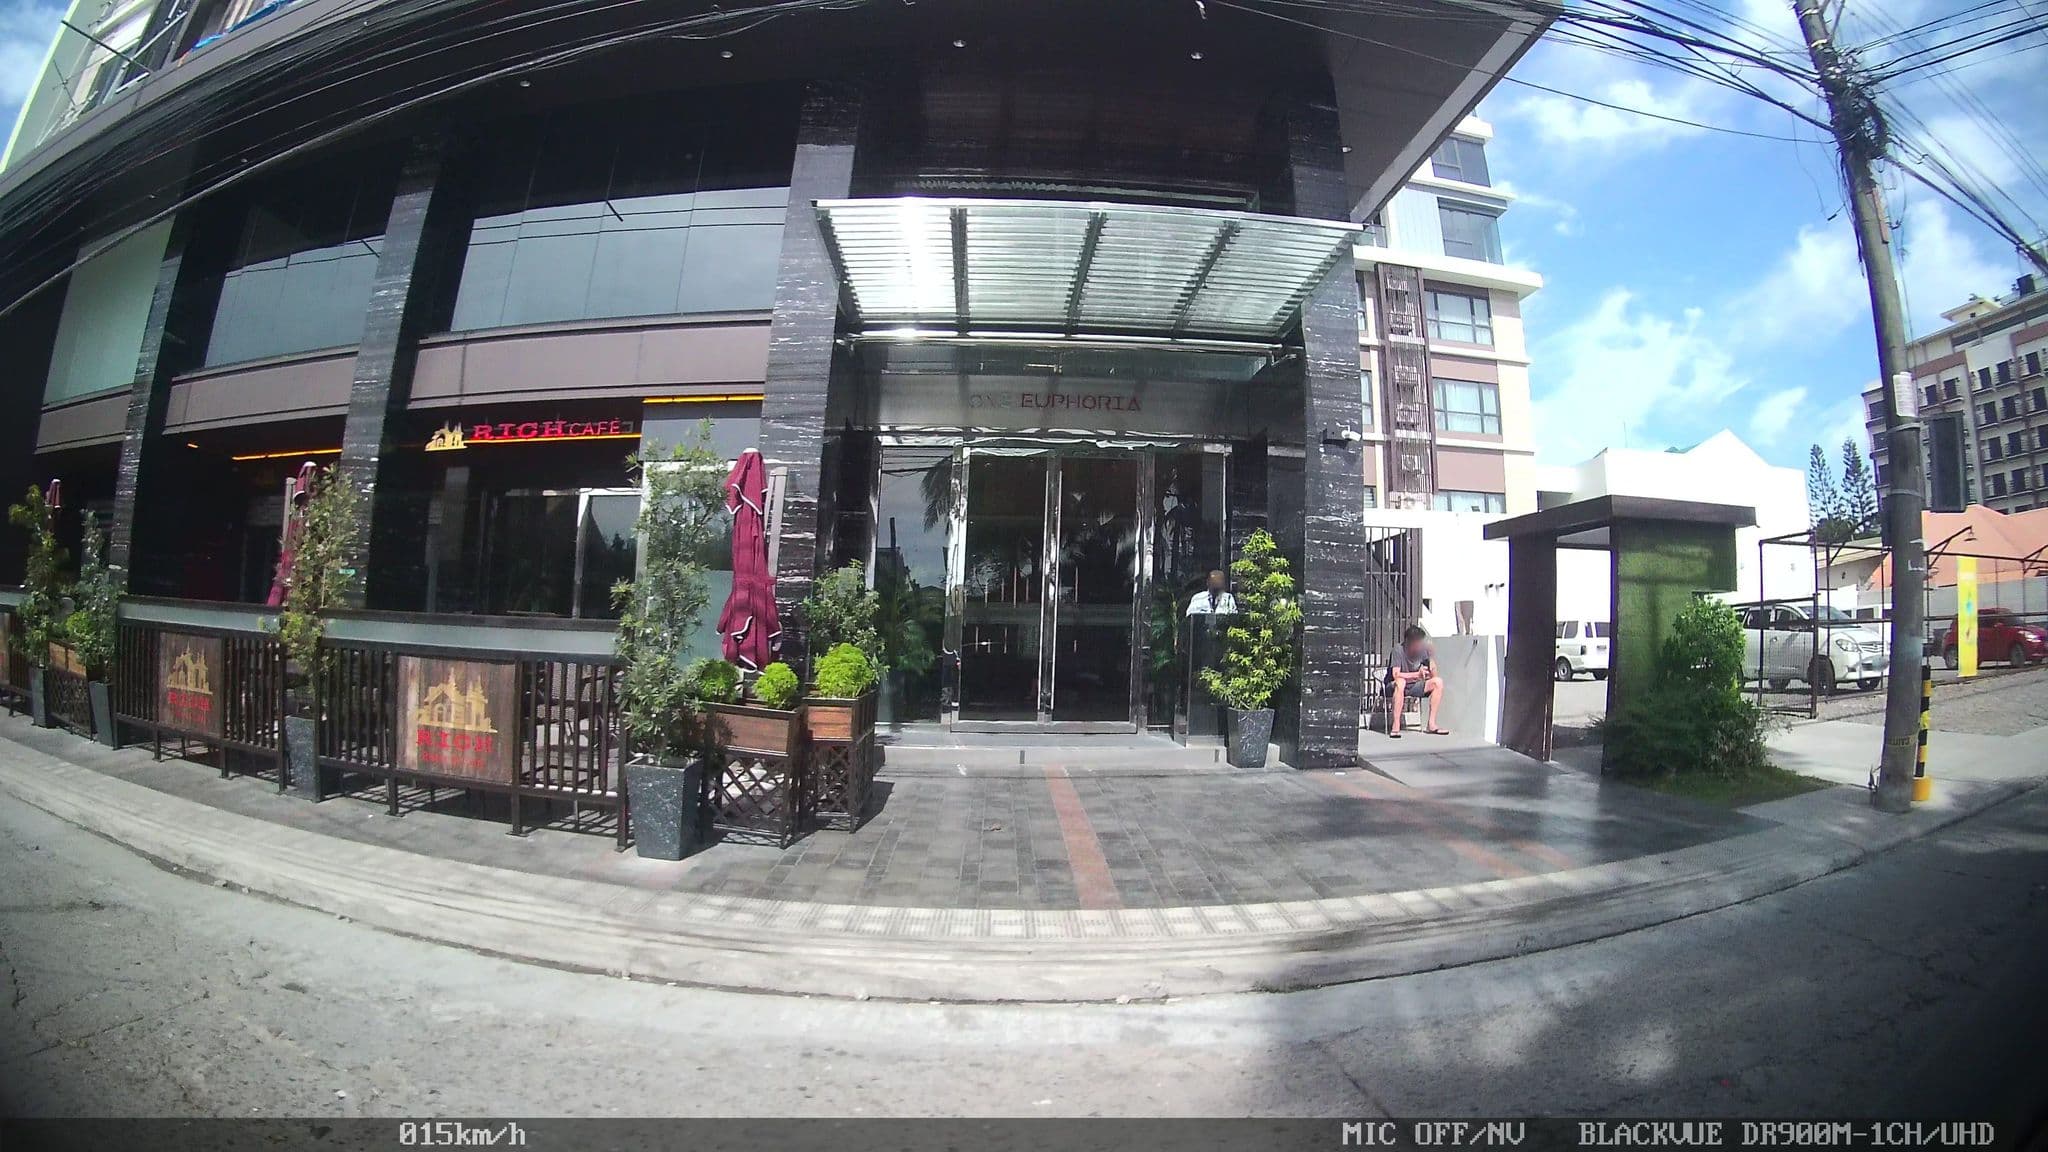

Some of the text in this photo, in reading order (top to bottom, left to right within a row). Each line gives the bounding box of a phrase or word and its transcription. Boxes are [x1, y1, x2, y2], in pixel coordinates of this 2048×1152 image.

[1021, 392, 1142, 412] EUPHORIA
[473, 416, 622, 441] RICH CAFÉ
[416, 728, 495, 754] RICH
